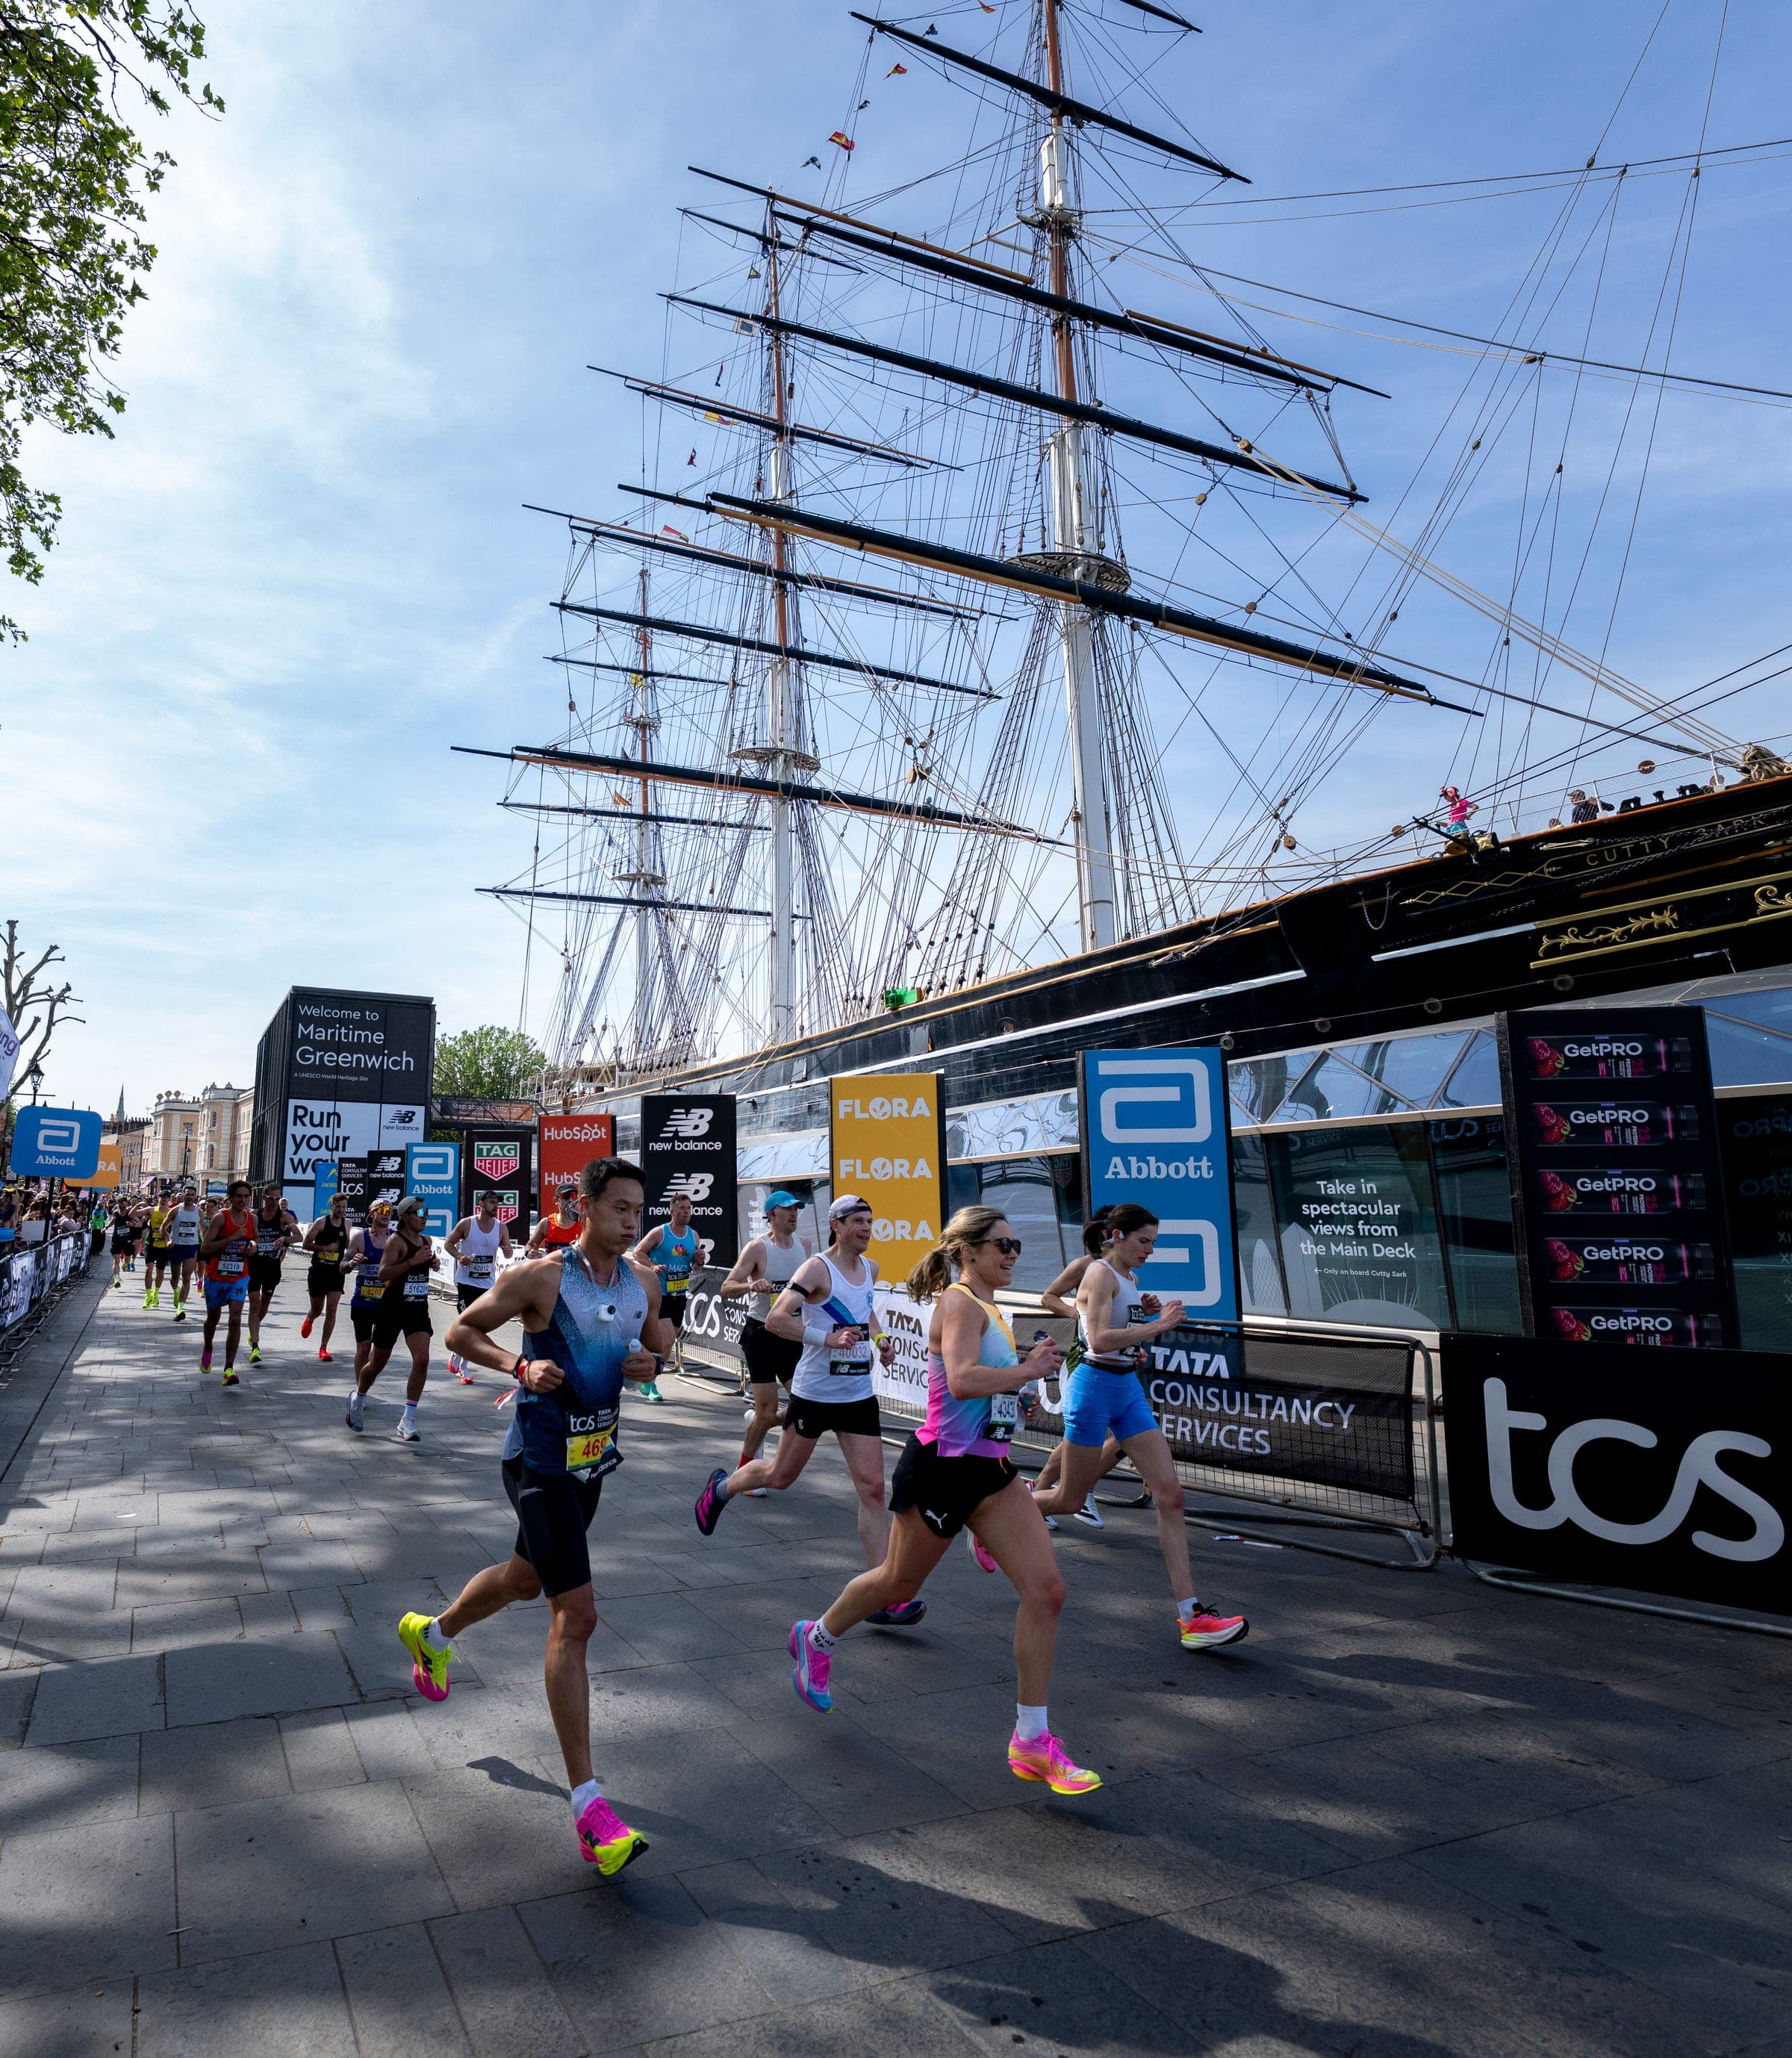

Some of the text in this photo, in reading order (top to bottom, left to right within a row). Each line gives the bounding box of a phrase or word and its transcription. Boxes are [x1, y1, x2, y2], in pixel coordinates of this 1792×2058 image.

[1587, 837, 1670, 866] CUTTY
[299, 1005, 379, 1021] Welcome to
[298, 1023, 385, 1044] Maritime
[0, 1031, 17, 1057] ng
[1564, 1042, 1643, 1057] GetPRO
[296, 1046, 414, 1071] Greenwich
[293, 1105, 341, 1128] Run
[839, 1097, 931, 1120] FLORA
[1570, 1110, 1649, 1124] GetPRO
[544, 1123, 607, 1142] HubSpot
[291, 1134, 350, 1155] your
[479, 1145, 515, 1156] TAG
[649, 1140, 723, 1151] new balance
[35, 1155, 75, 1166] Abbott
[477, 1160, 516, 1178] HEUER
[839, 1157, 933, 1181] FLORA
[1104, 1157, 1213, 1178] Abbott
[545, 1172, 580, 1185] HubS
[1316, 1178, 1377, 1195] Take in
[1576, 1178, 1656, 1191] GetPRO
[341, 1181, 364, 1195] tcs
[412, 1184, 452, 1194] Abbott
[649, 1206, 723, 1216] new lance
[1301, 1200, 1401, 1218] spectacular
[1310, 1219, 1399, 1237] views from
[1300, 1240, 1416, 1259] the Main Deck
[1583, 1246, 1664, 1260] GetPRO
[1350, 1268, 1369, 1276] board
[1372, 1269, 1390, 1278] Cutty
[886, 1310, 923, 1337] TATA
[1590, 1316, 1672, 1331] GetPRO
[1151, 1346, 1230, 1378] TATA
[883, 1363, 928, 1388] SERVIC
[1150, 1379, 1356, 1429] CONSULTANCY
[570, 1415, 595, 1432] tcs
[1152, 1411, 1272, 1455] ERVICES
[1483, 1378, 1785, 1562] tcs
